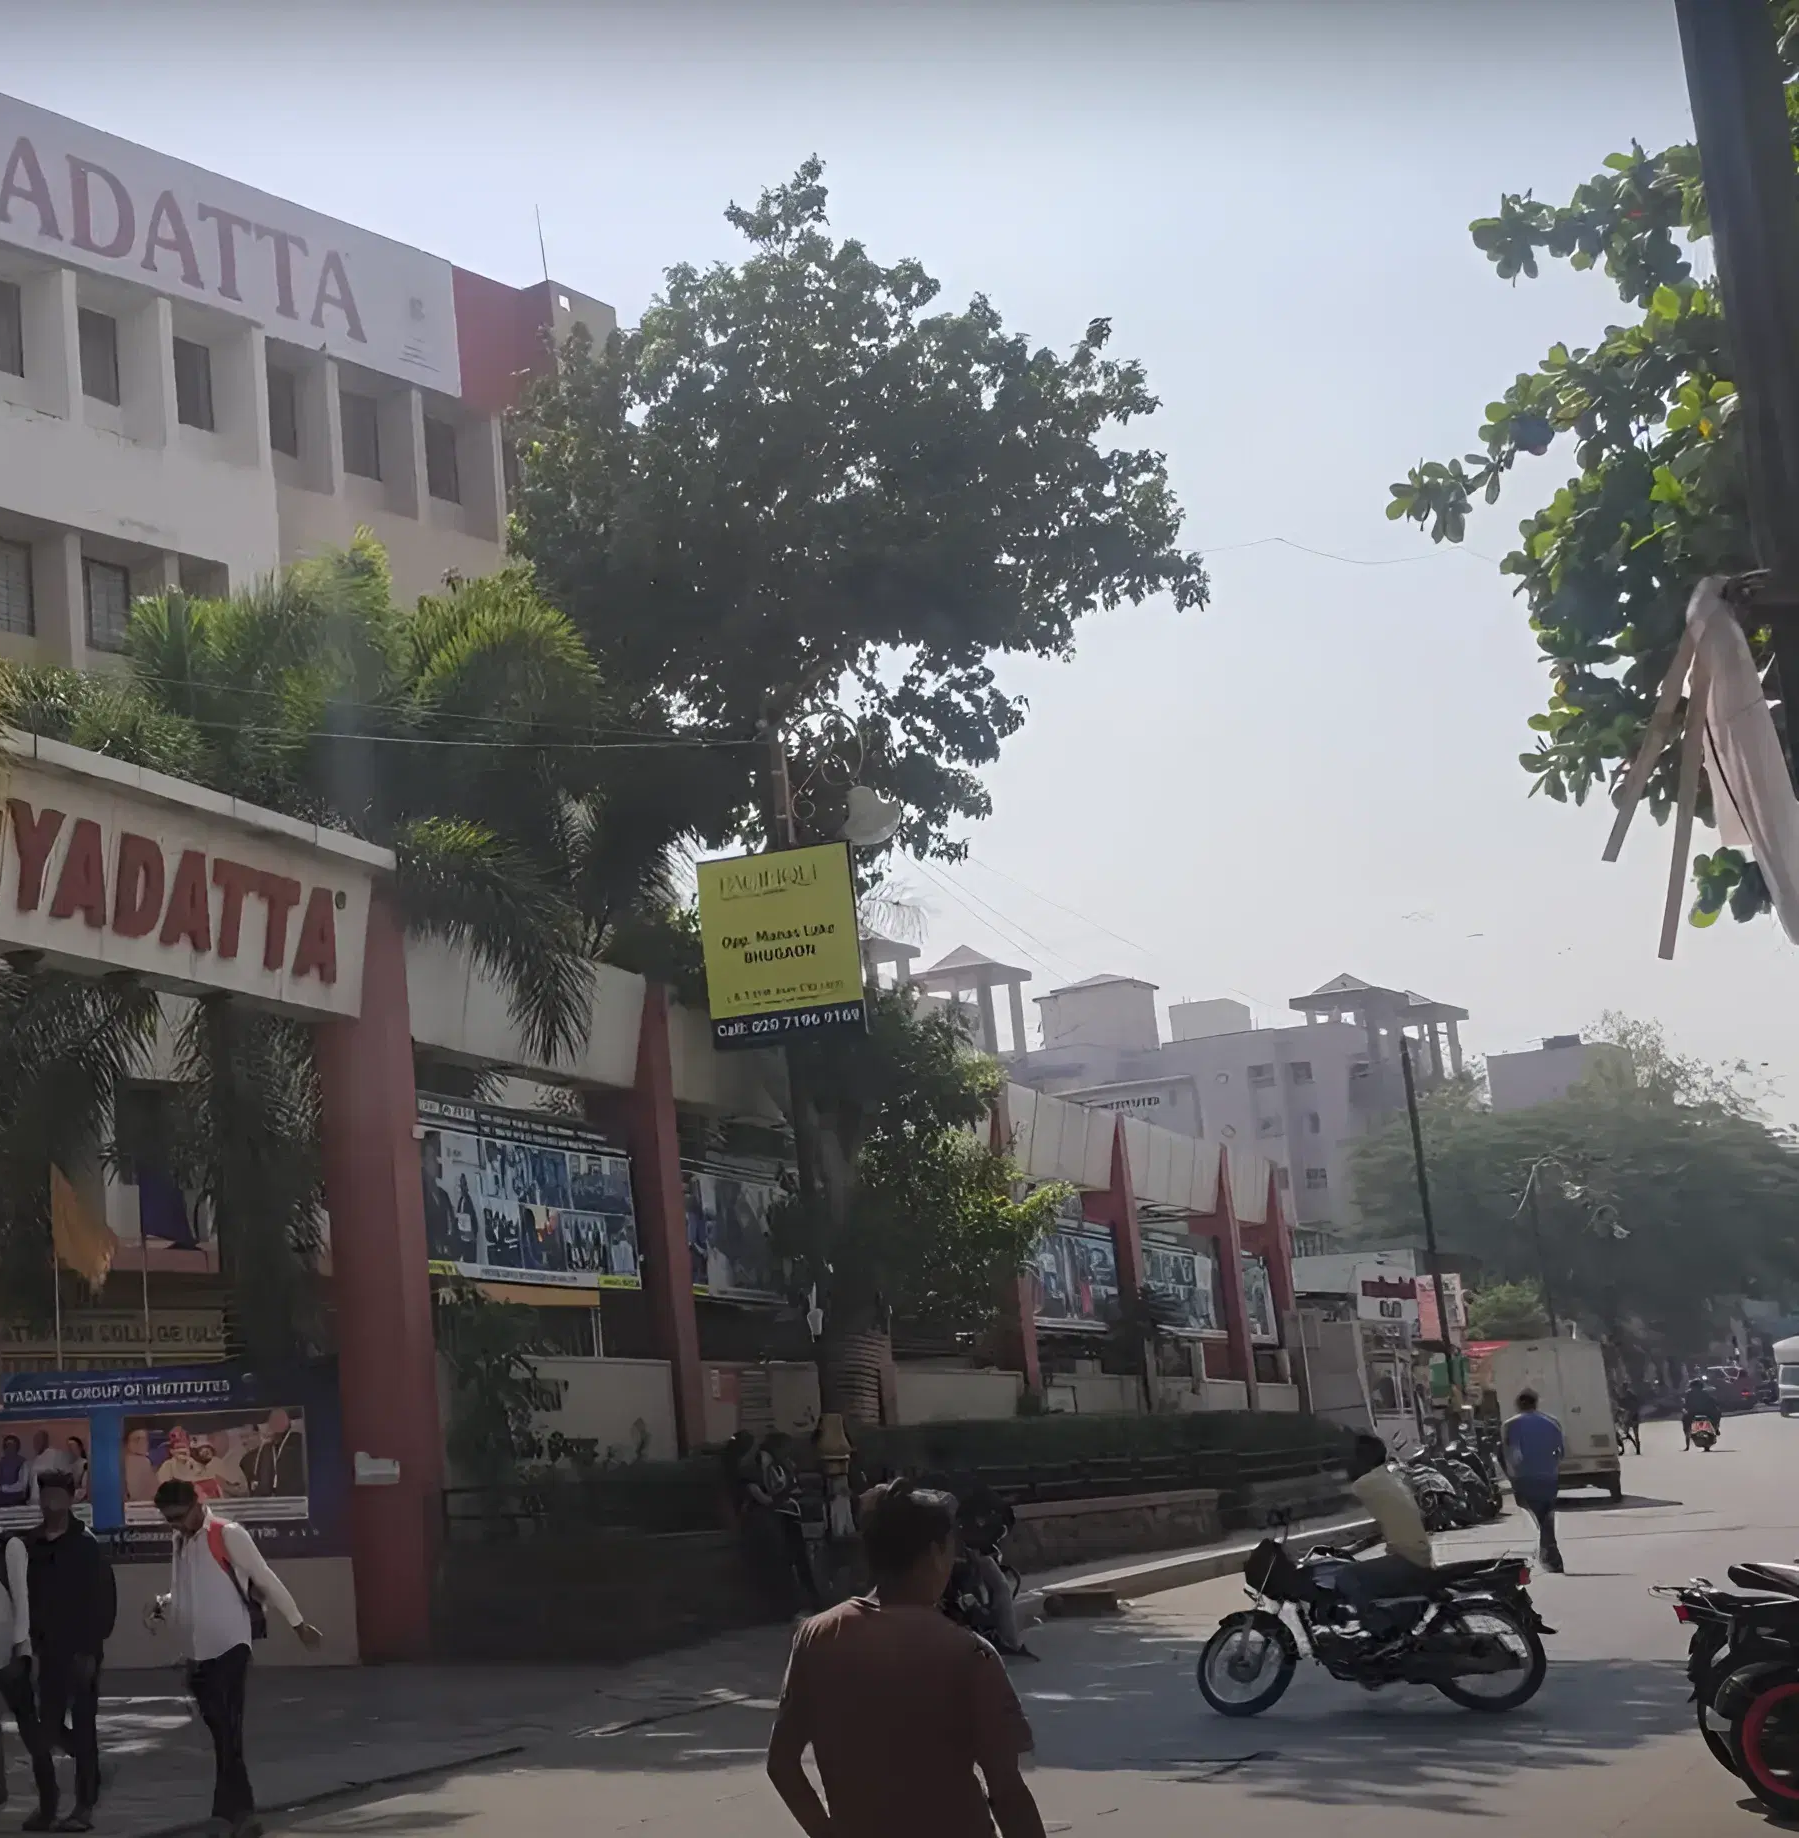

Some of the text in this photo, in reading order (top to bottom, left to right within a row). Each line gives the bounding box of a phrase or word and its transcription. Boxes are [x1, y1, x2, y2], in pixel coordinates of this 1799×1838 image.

[756, 928, 801, 943] Manas
[744, 944, 817, 964] BHUGAON
[752, 1017, 779, 1033] 020
[70, 1384, 122, 1401] GROUP
[146, 1379, 230, 1396] INSTITUTES
